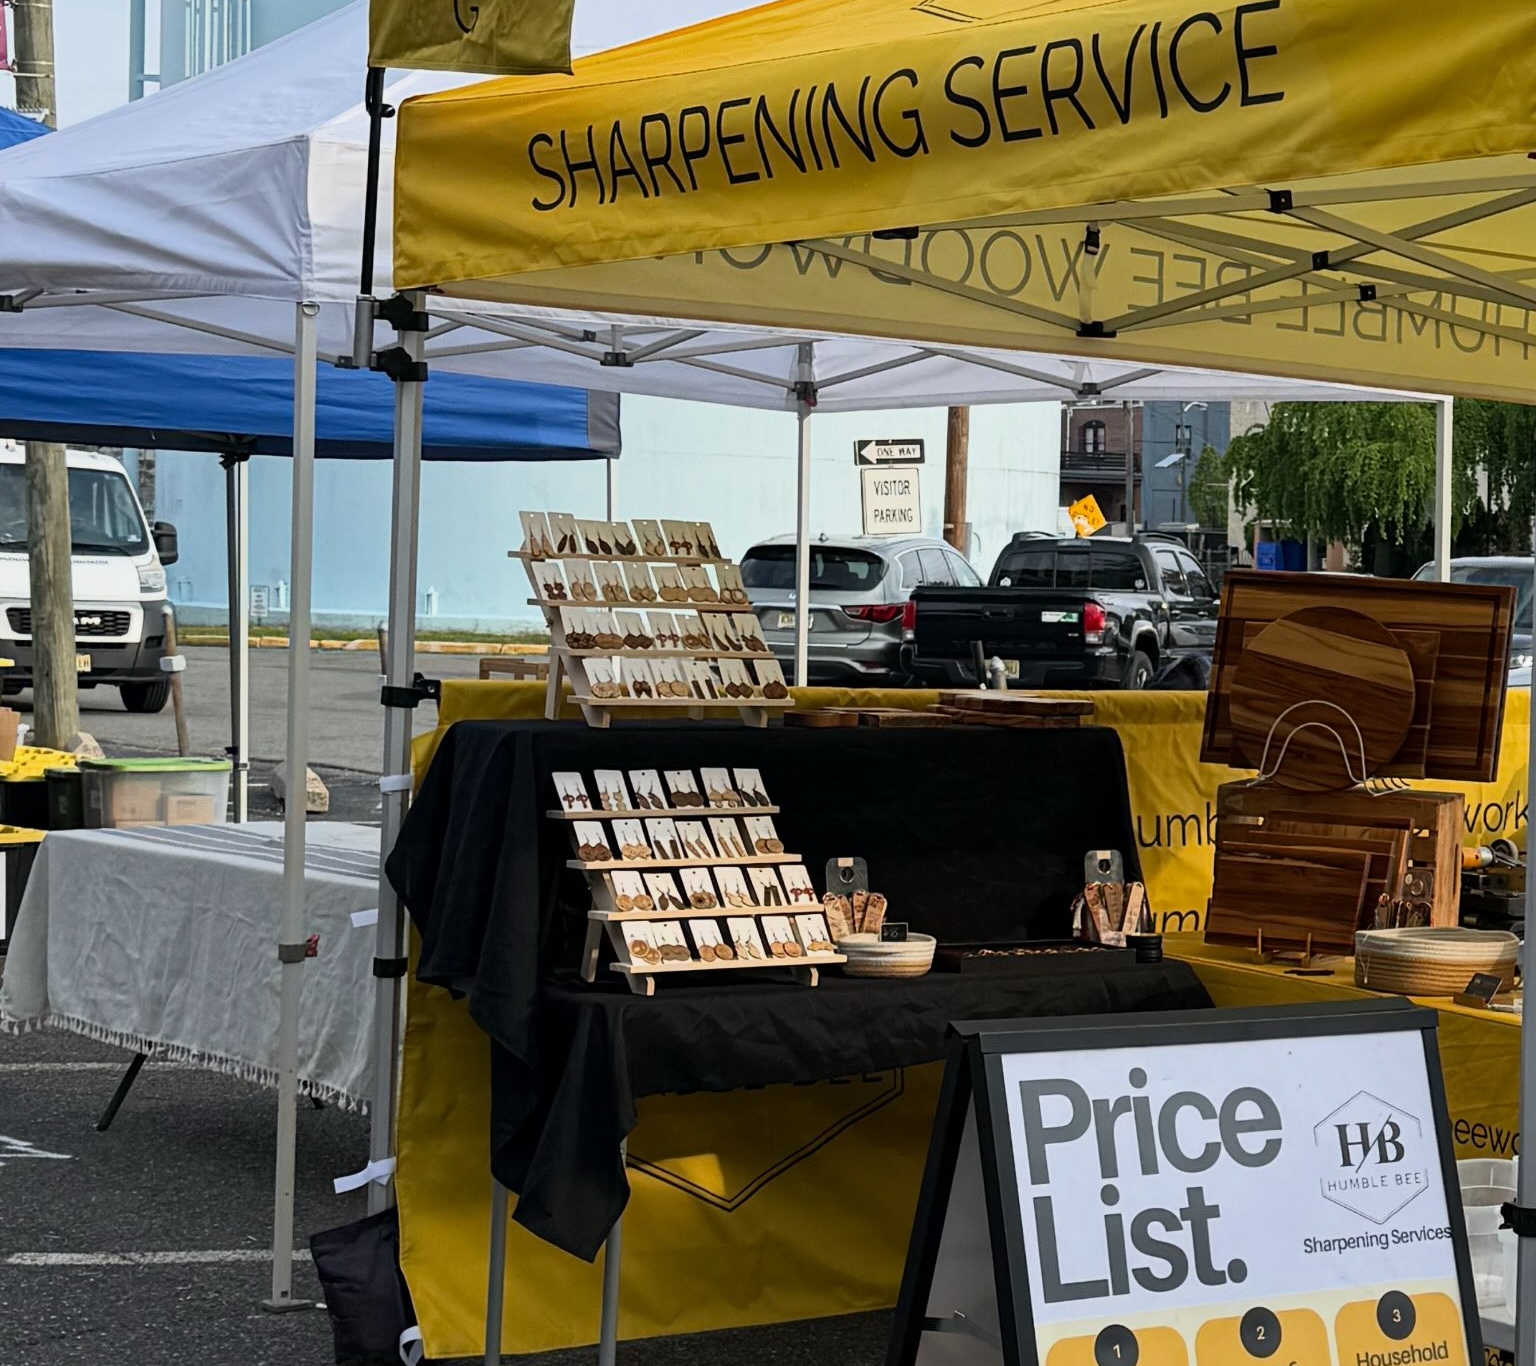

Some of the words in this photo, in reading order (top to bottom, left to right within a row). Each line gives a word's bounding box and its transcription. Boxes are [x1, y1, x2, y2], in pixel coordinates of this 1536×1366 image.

[527, 68, 924, 211] SHARPENING
[877, 447, 894, 456] ONE
[898, 447, 917, 456] WAY
[873, 480, 910, 495] VISITOR
[874, 508, 913, 523] PARKING
[1019, 1067, 1283, 1185] Price
[1327, 1175, 1388, 1192] HUMBLE
[1395, 1172, 1421, 1185] BEE
[1032, 1183, 1249, 1304] List.
[1303, 1231, 1389, 1255] Sharpening
[1391, 1225, 1452, 1245] Services
[1392, 1309, 1401, 1323] 3
[1256, 1326, 1265, 1340] 2
[1112, 1344, 1121, 1358] 1
